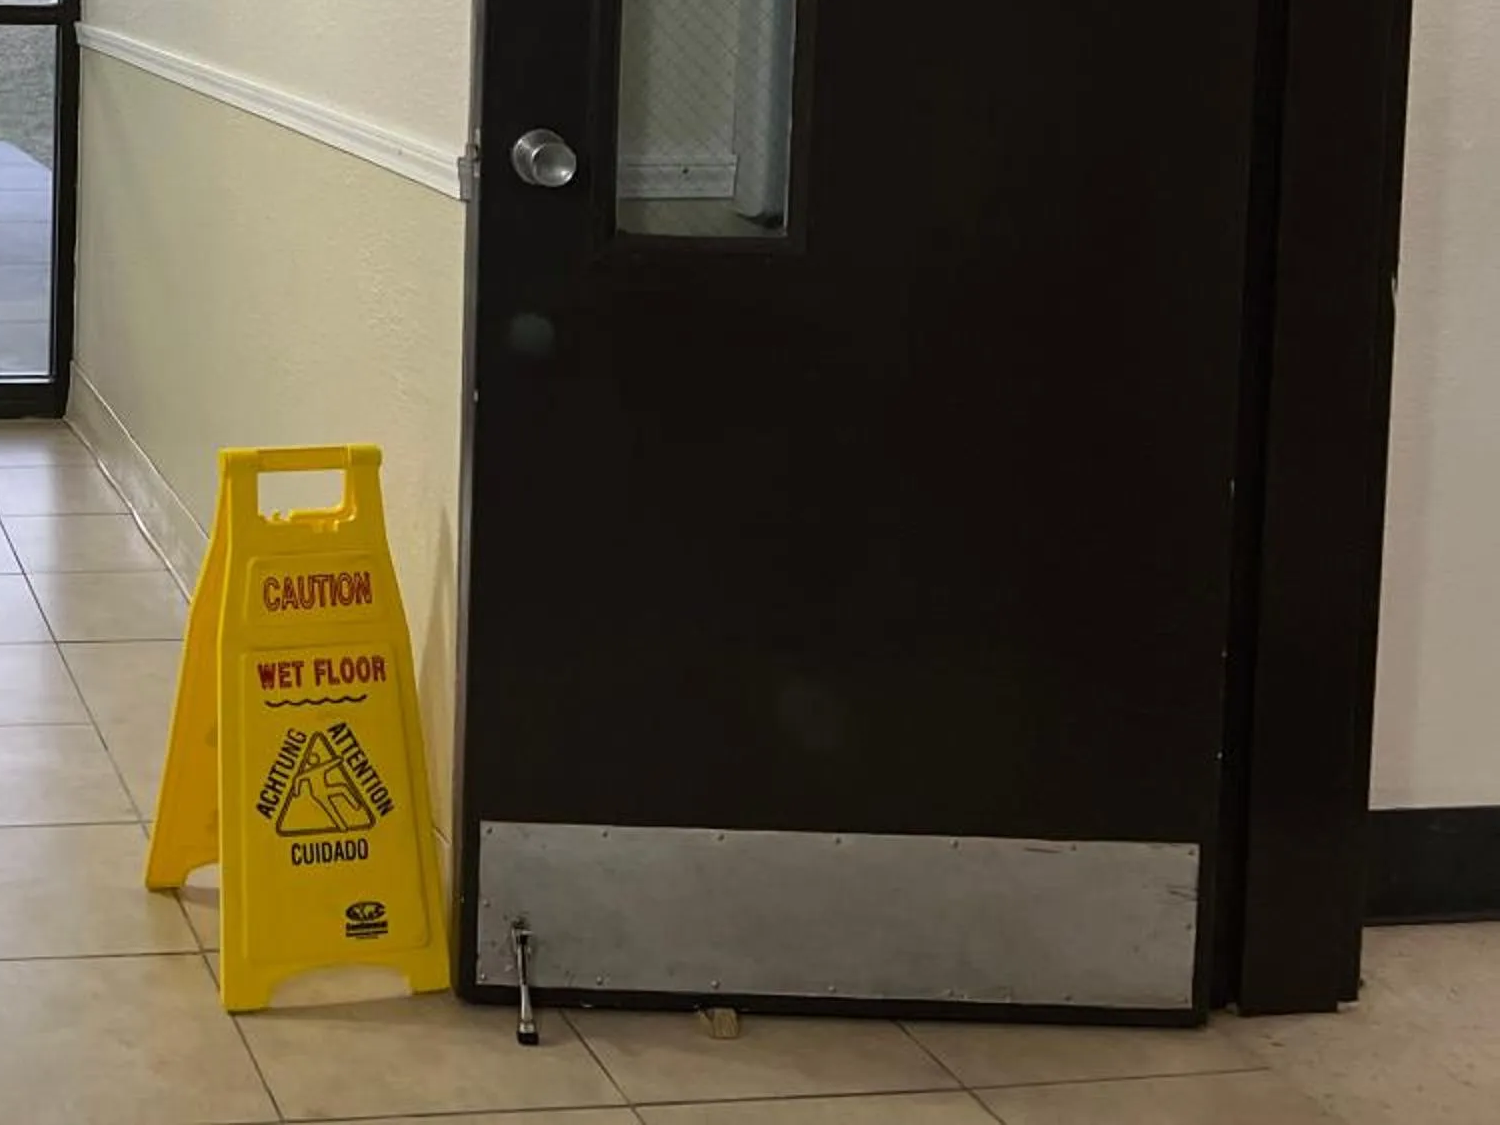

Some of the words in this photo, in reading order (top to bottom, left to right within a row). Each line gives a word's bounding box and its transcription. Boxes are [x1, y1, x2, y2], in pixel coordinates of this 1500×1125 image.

[263, 572, 373, 611] CAUTION
[257, 660, 305, 690] WET
[313, 655, 387, 687] FLOOR
[255, 727, 307, 820] ACHTUNG
[327, 722, 395, 817] ATTENTION
[291, 838, 369, 866] CUIDADO
